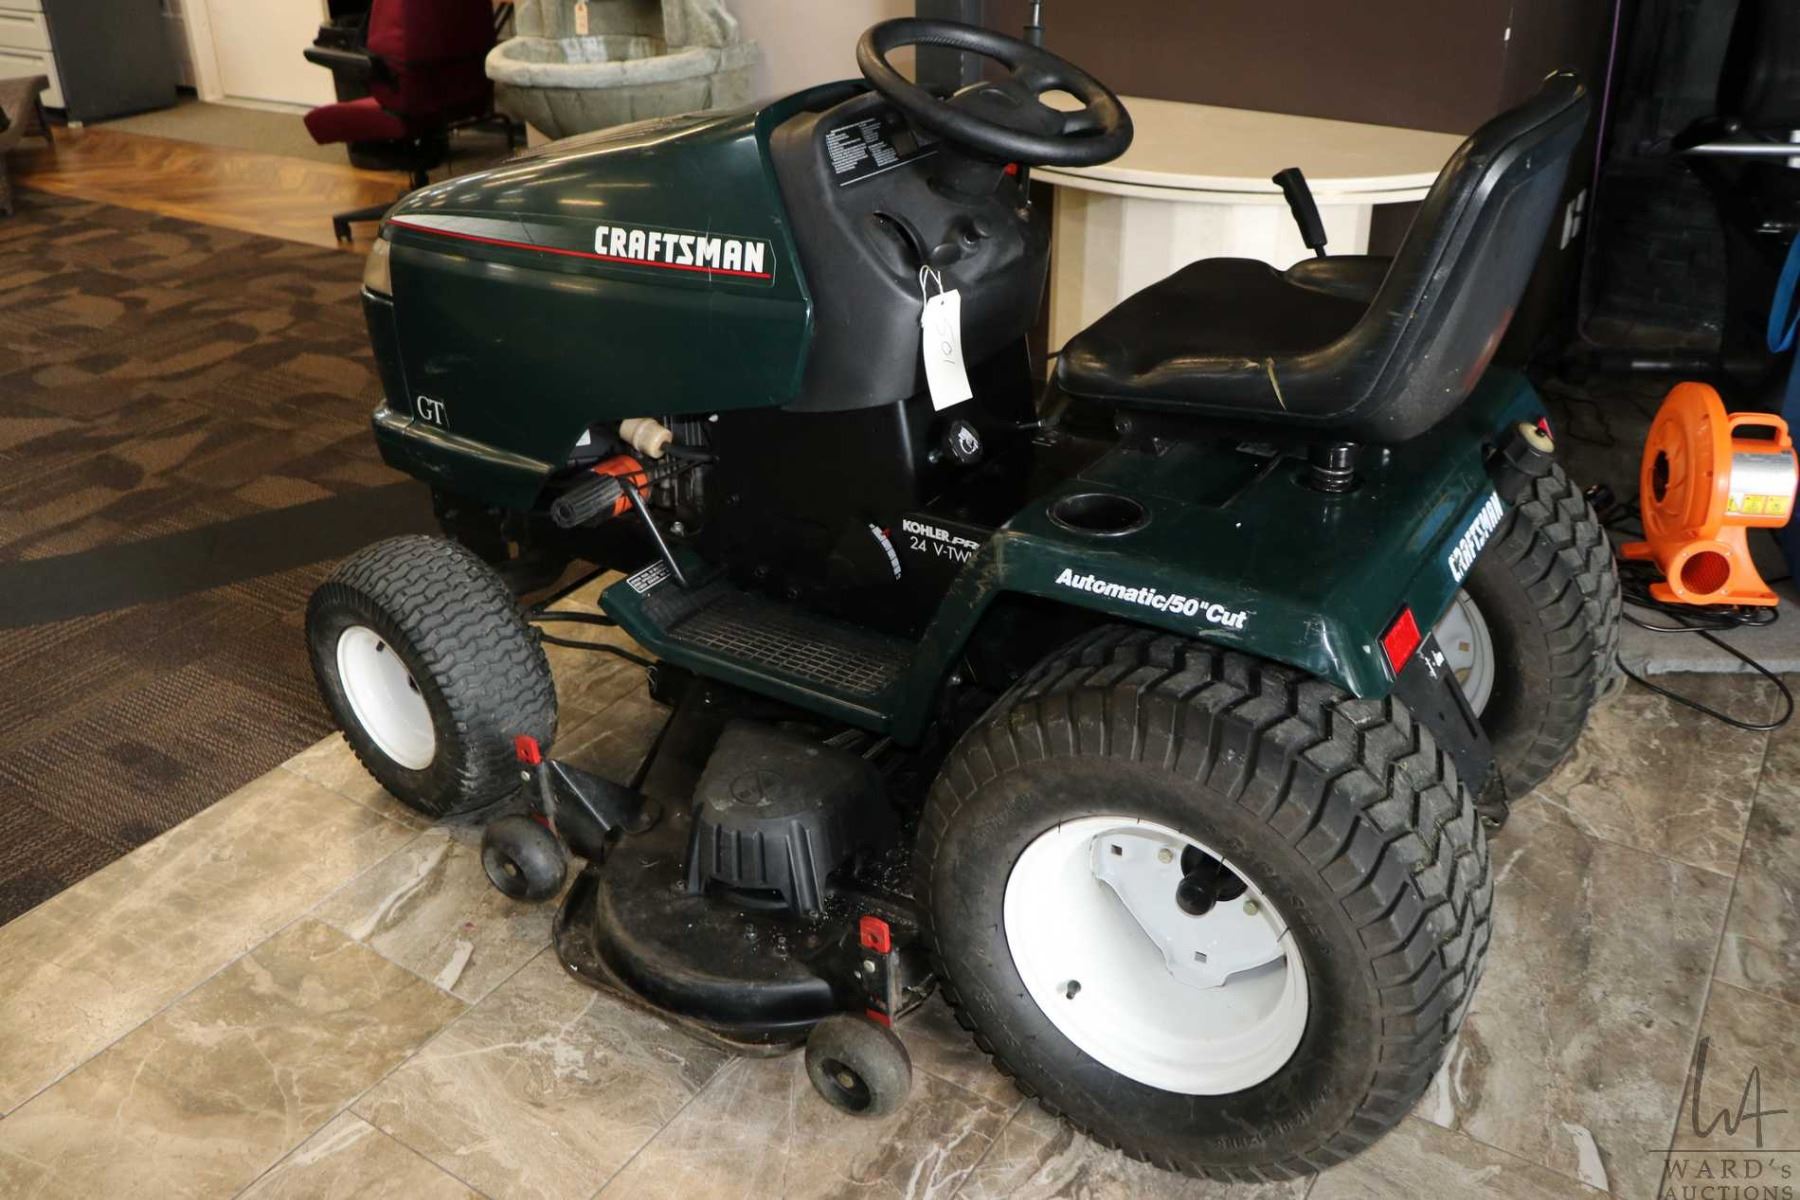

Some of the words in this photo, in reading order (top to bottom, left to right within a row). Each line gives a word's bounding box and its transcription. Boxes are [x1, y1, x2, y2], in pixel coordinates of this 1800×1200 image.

[594, 225, 766, 274] CRAFTSMAN
[416, 395, 445, 425] GT
[902, 519, 950, 543] KOHLER
[951, 536, 980, 550] PR
[910, 535, 927, 552] 24
[1447, 489, 1504, 584] CRAFTSMAN
